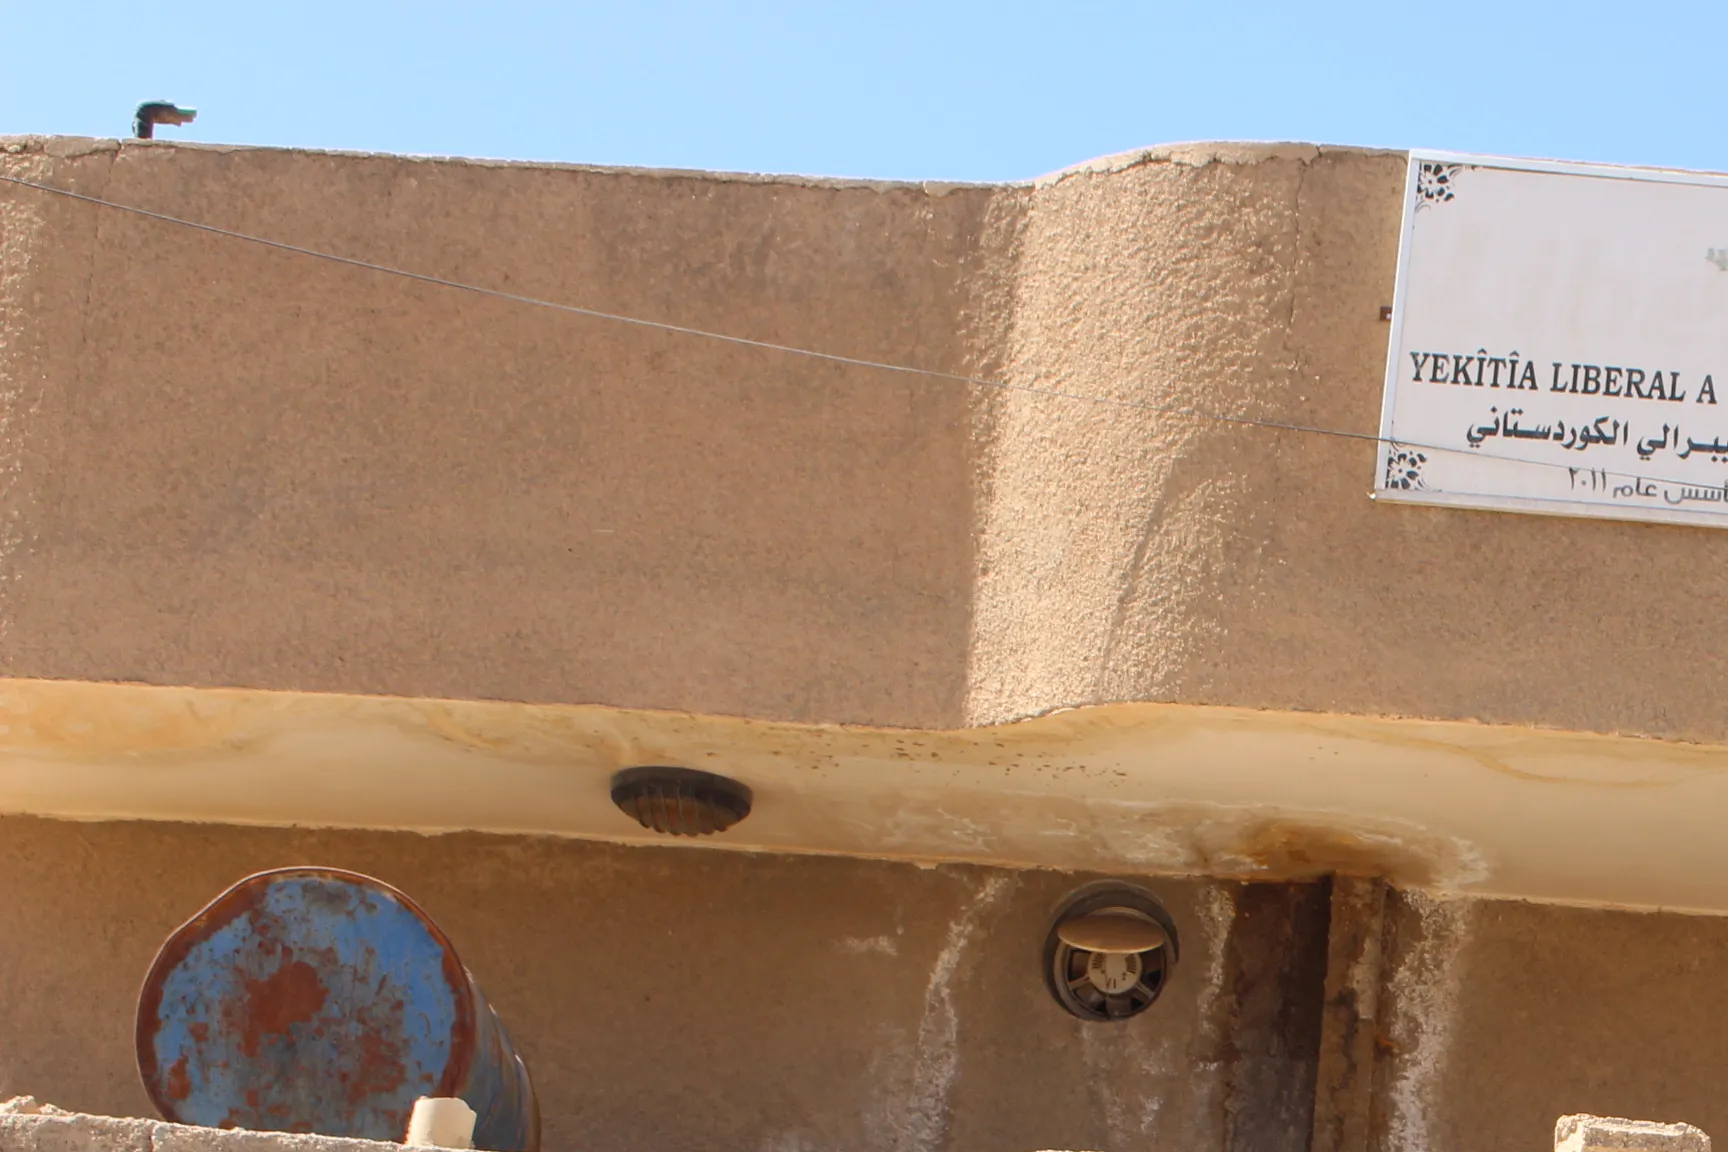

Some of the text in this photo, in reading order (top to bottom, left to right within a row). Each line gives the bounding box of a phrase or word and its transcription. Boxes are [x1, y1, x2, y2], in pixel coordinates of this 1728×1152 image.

[1410, 348, 1538, 390] YEKÎTÎA
[1550, 362, 1686, 402] LIBERAL
[1696, 374, 1717, 404] A
[1466, 406, 1629, 450] الكوردستاني
[1613, 476, 1658, 499] عام
